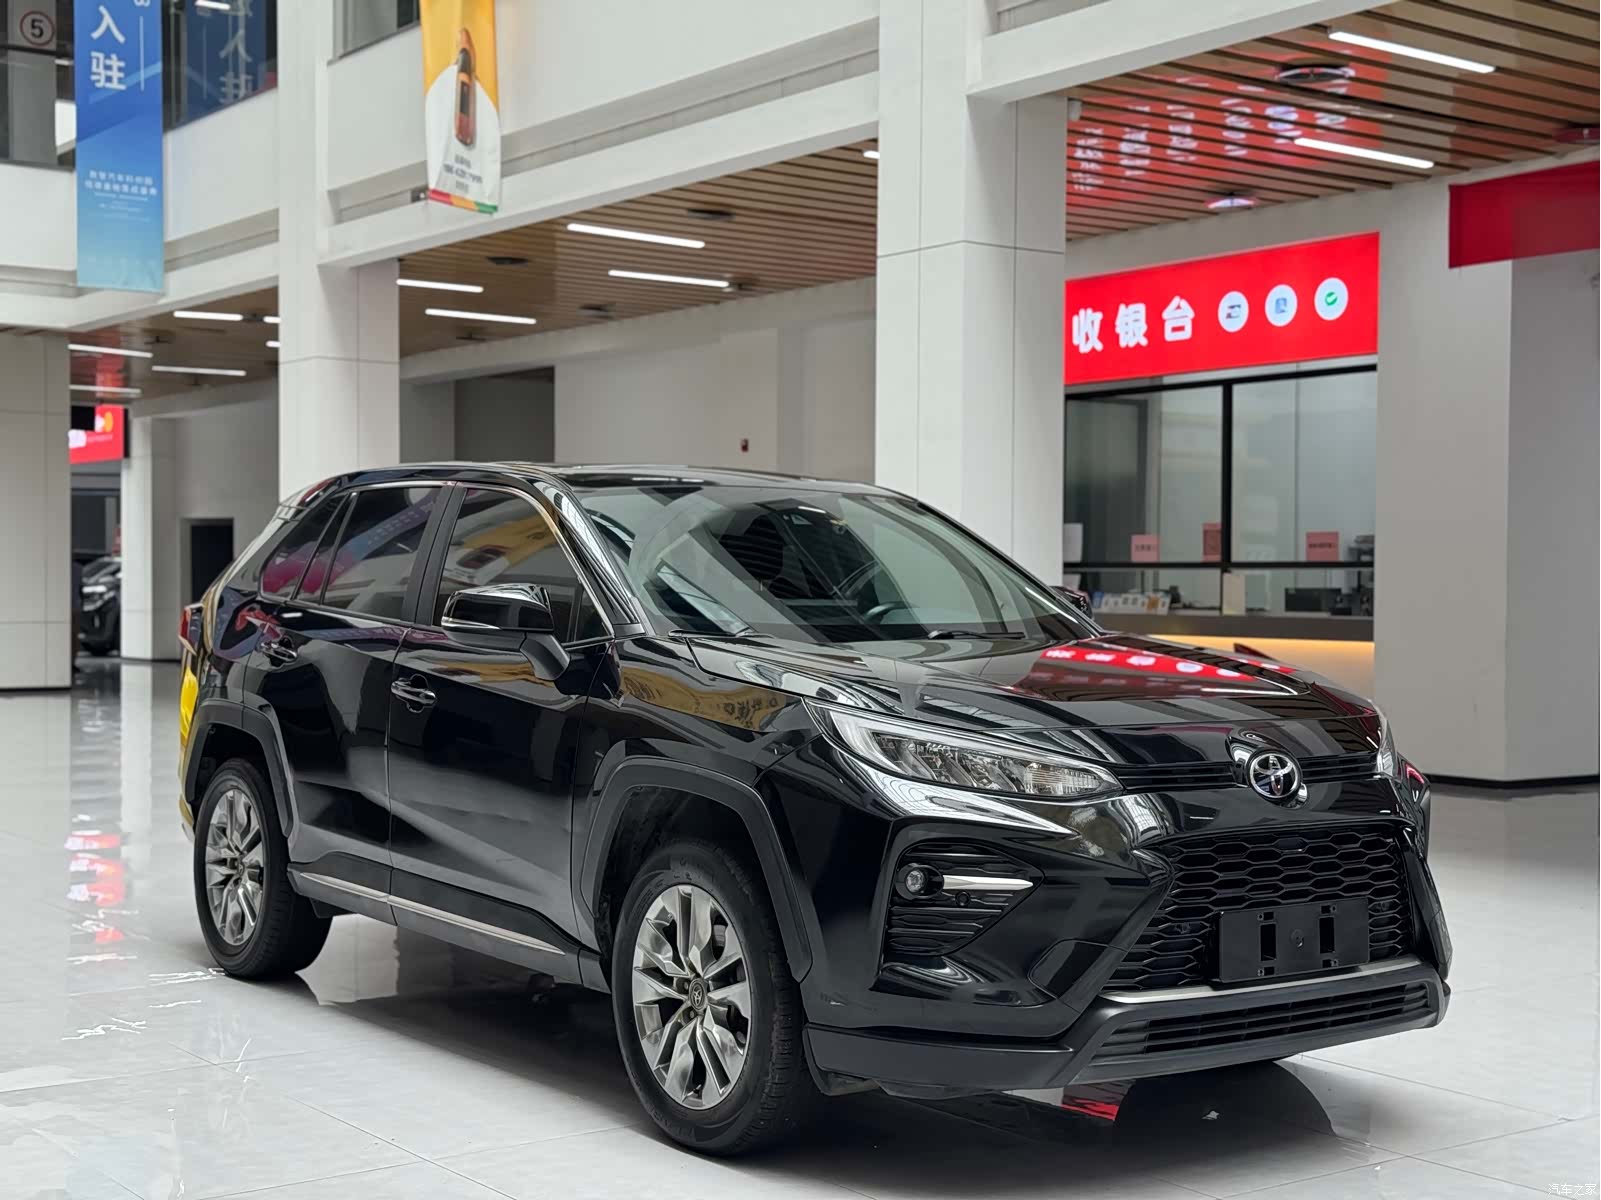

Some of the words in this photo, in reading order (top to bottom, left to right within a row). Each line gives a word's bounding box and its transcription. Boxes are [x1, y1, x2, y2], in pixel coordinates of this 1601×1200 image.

[30, 18, 44, 39] 5
[90, 5, 127, 91] 入驻
[1072, 296, 1195, 353] 收银台
